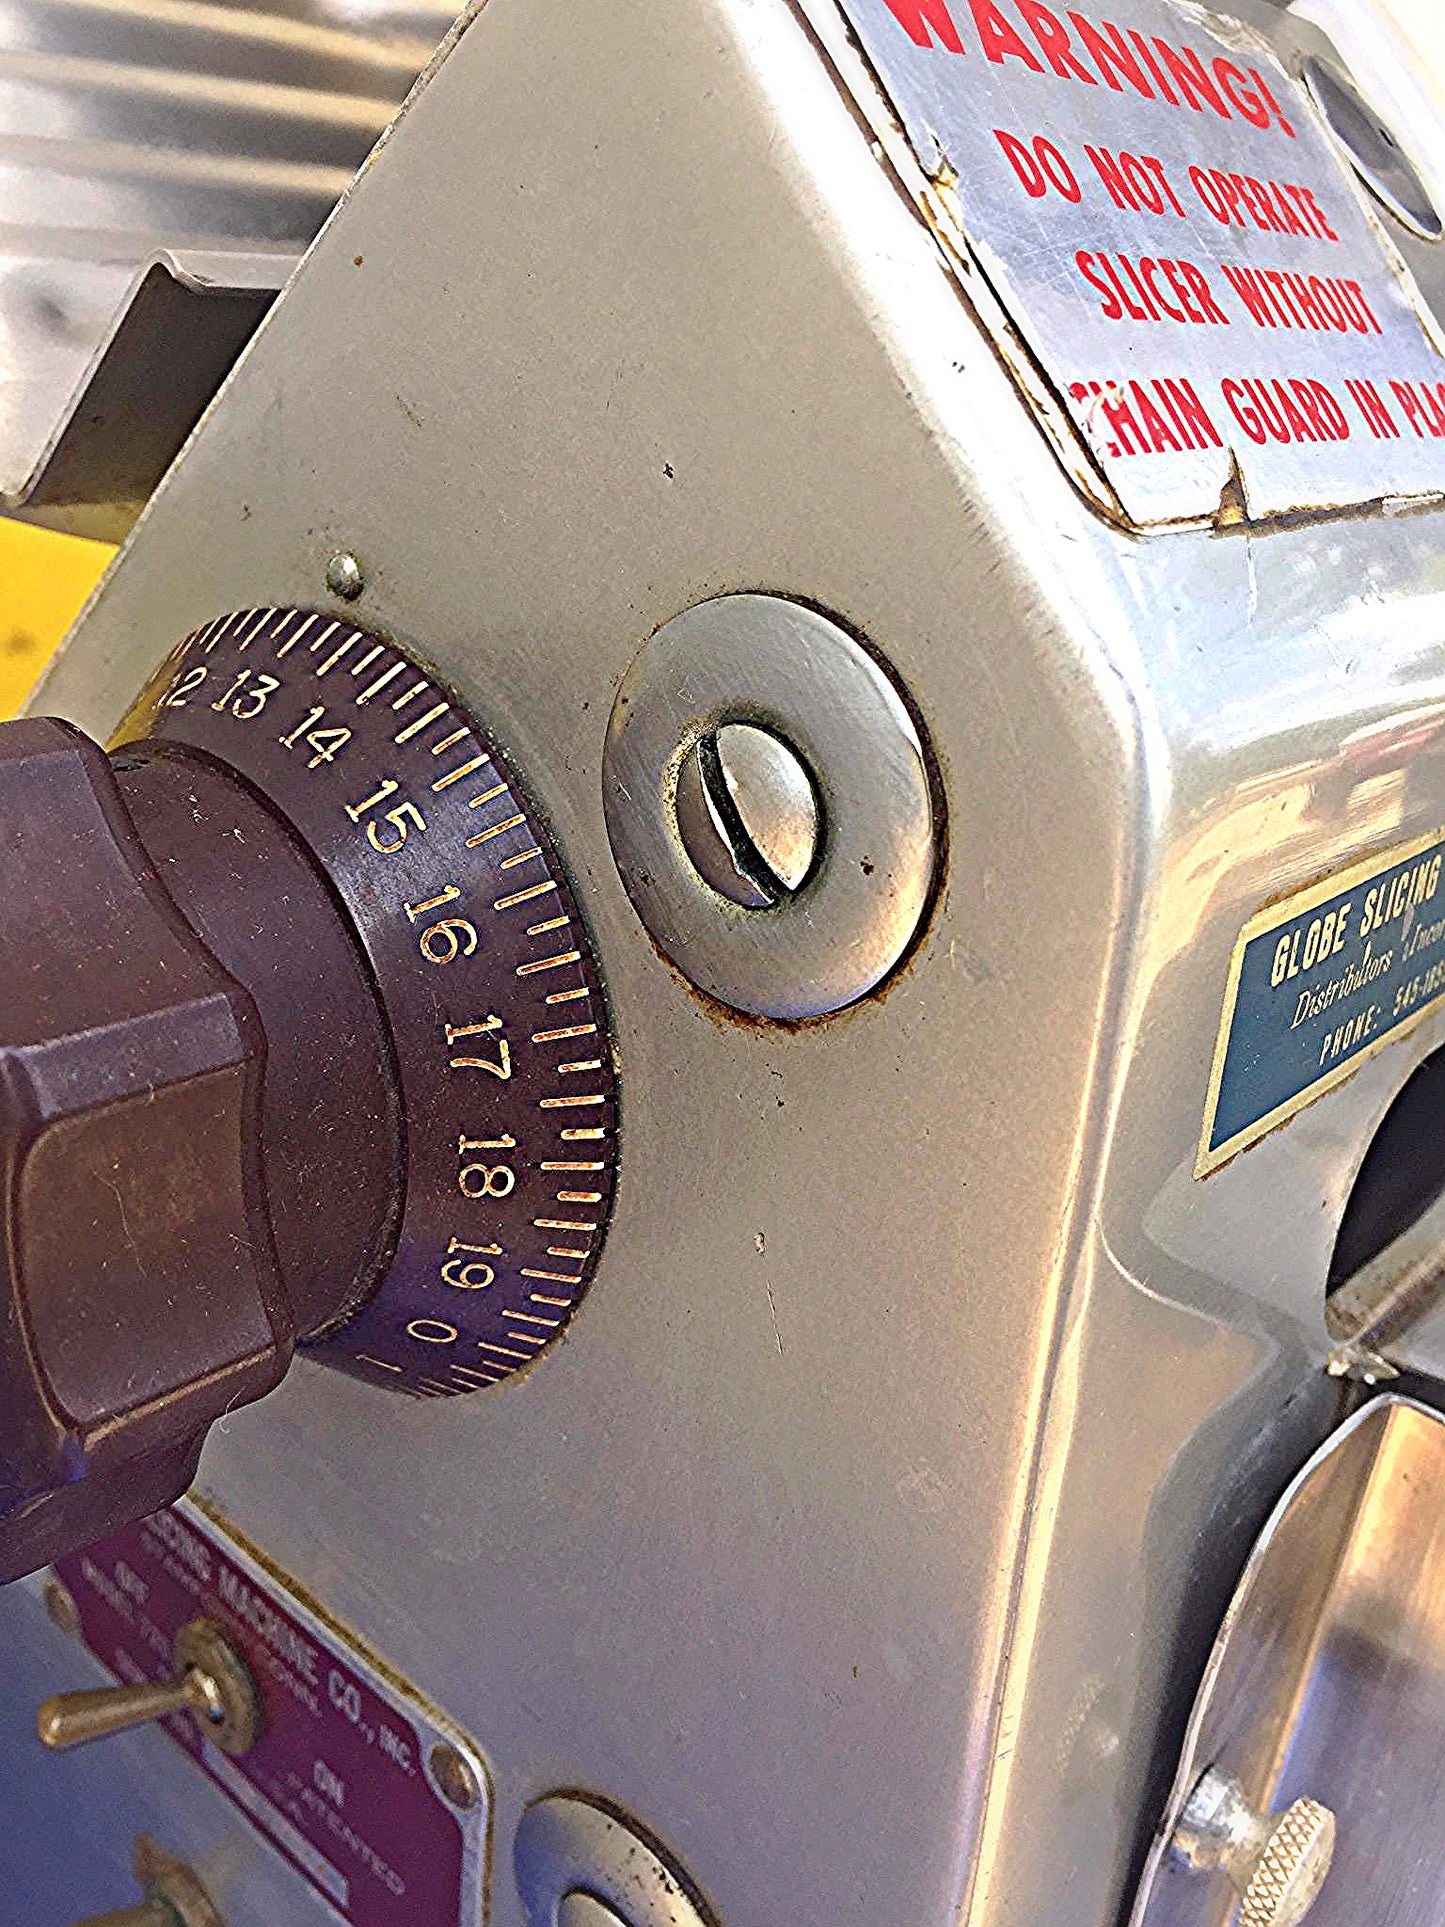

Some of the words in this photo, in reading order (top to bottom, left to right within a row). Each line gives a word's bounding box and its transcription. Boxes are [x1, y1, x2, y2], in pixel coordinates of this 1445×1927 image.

[992, 129, 1082, 204] DO
[1083, 144, 1186, 220] NOT
[1188, 165, 1339, 242] OPERATE
[1075, 249, 1230, 325] SLICER
[1220, 264, 1384, 336] WITHOUT
[1221, 378, 1349, 445] GUARD
[1344, 379, 1401, 439] IN
[1388, 380, 1445, 438] PLA
[210, 669, 280, 719] 13
[278, 705, 352, 769] 14
[345, 779, 428, 855] 15
[404, 884, 479, 965] 16
[1270, 903, 1351, 987] GLOBE
[1360, 854, 1442, 938] SLICING
[1290, 941, 1393, 1031] Distributors
[445, 1014, 511, 1080] 17
[1319, 1005, 1382, 1066] PHONE:
[459, 1134, 516, 1198] 18
[441, 1236, 504, 1290] 19
[407, 1319, 458, 1343] 0
